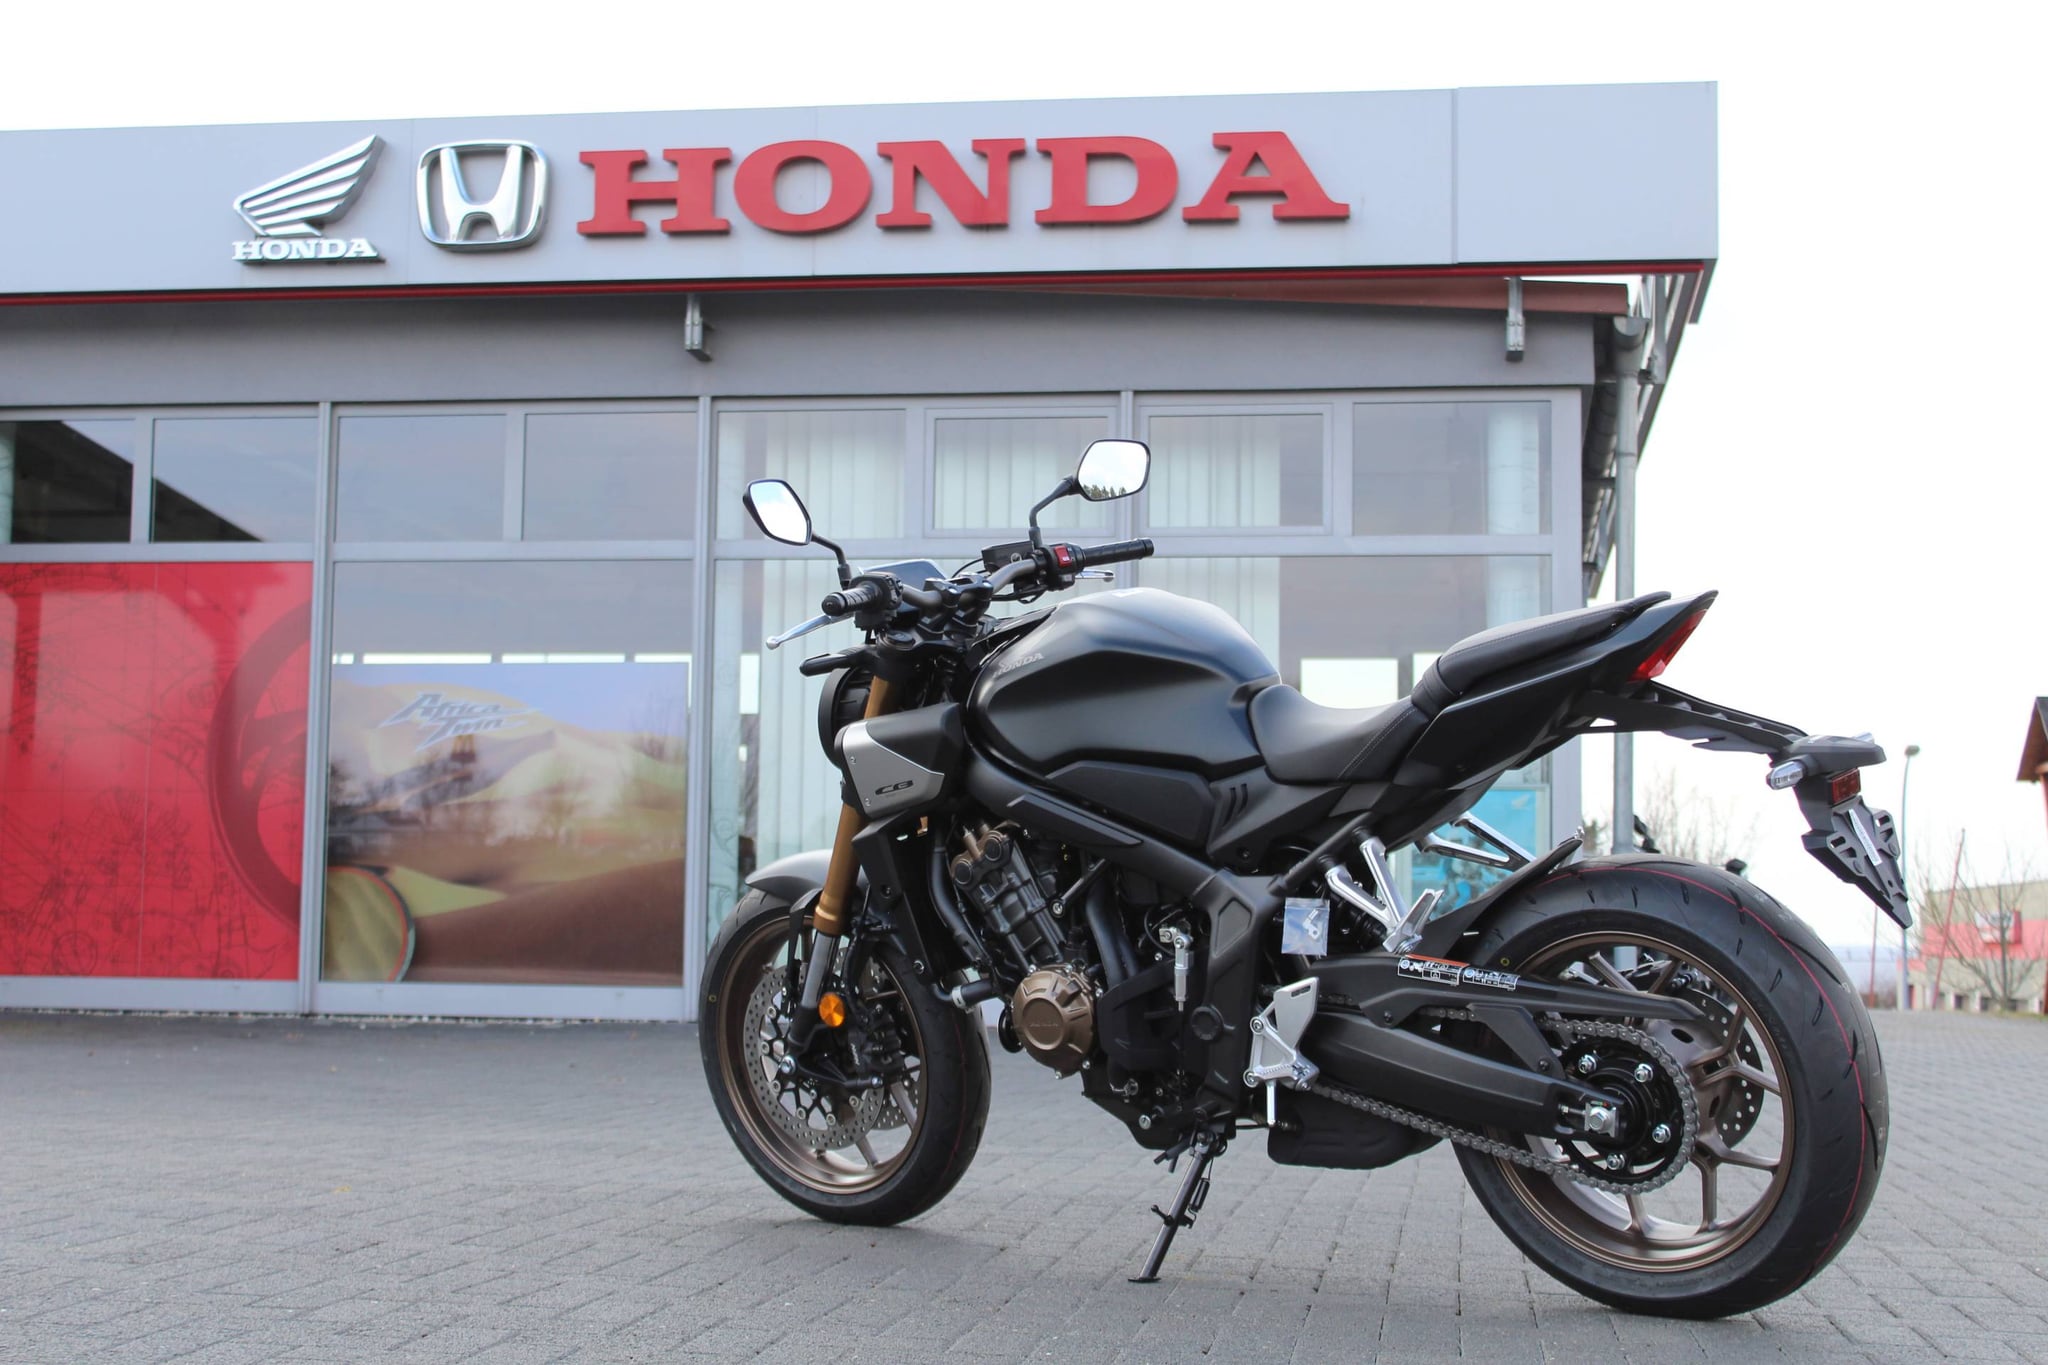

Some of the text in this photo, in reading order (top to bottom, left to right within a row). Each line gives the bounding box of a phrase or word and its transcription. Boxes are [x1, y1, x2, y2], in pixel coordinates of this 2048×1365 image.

[577, 131, 1351, 237] HONDA
[231, 238, 379, 261] HONDA
[992, 653, 1045, 678] HONDA
[380, 691, 510, 728] Africa
[416, 717, 506, 752] Twin
